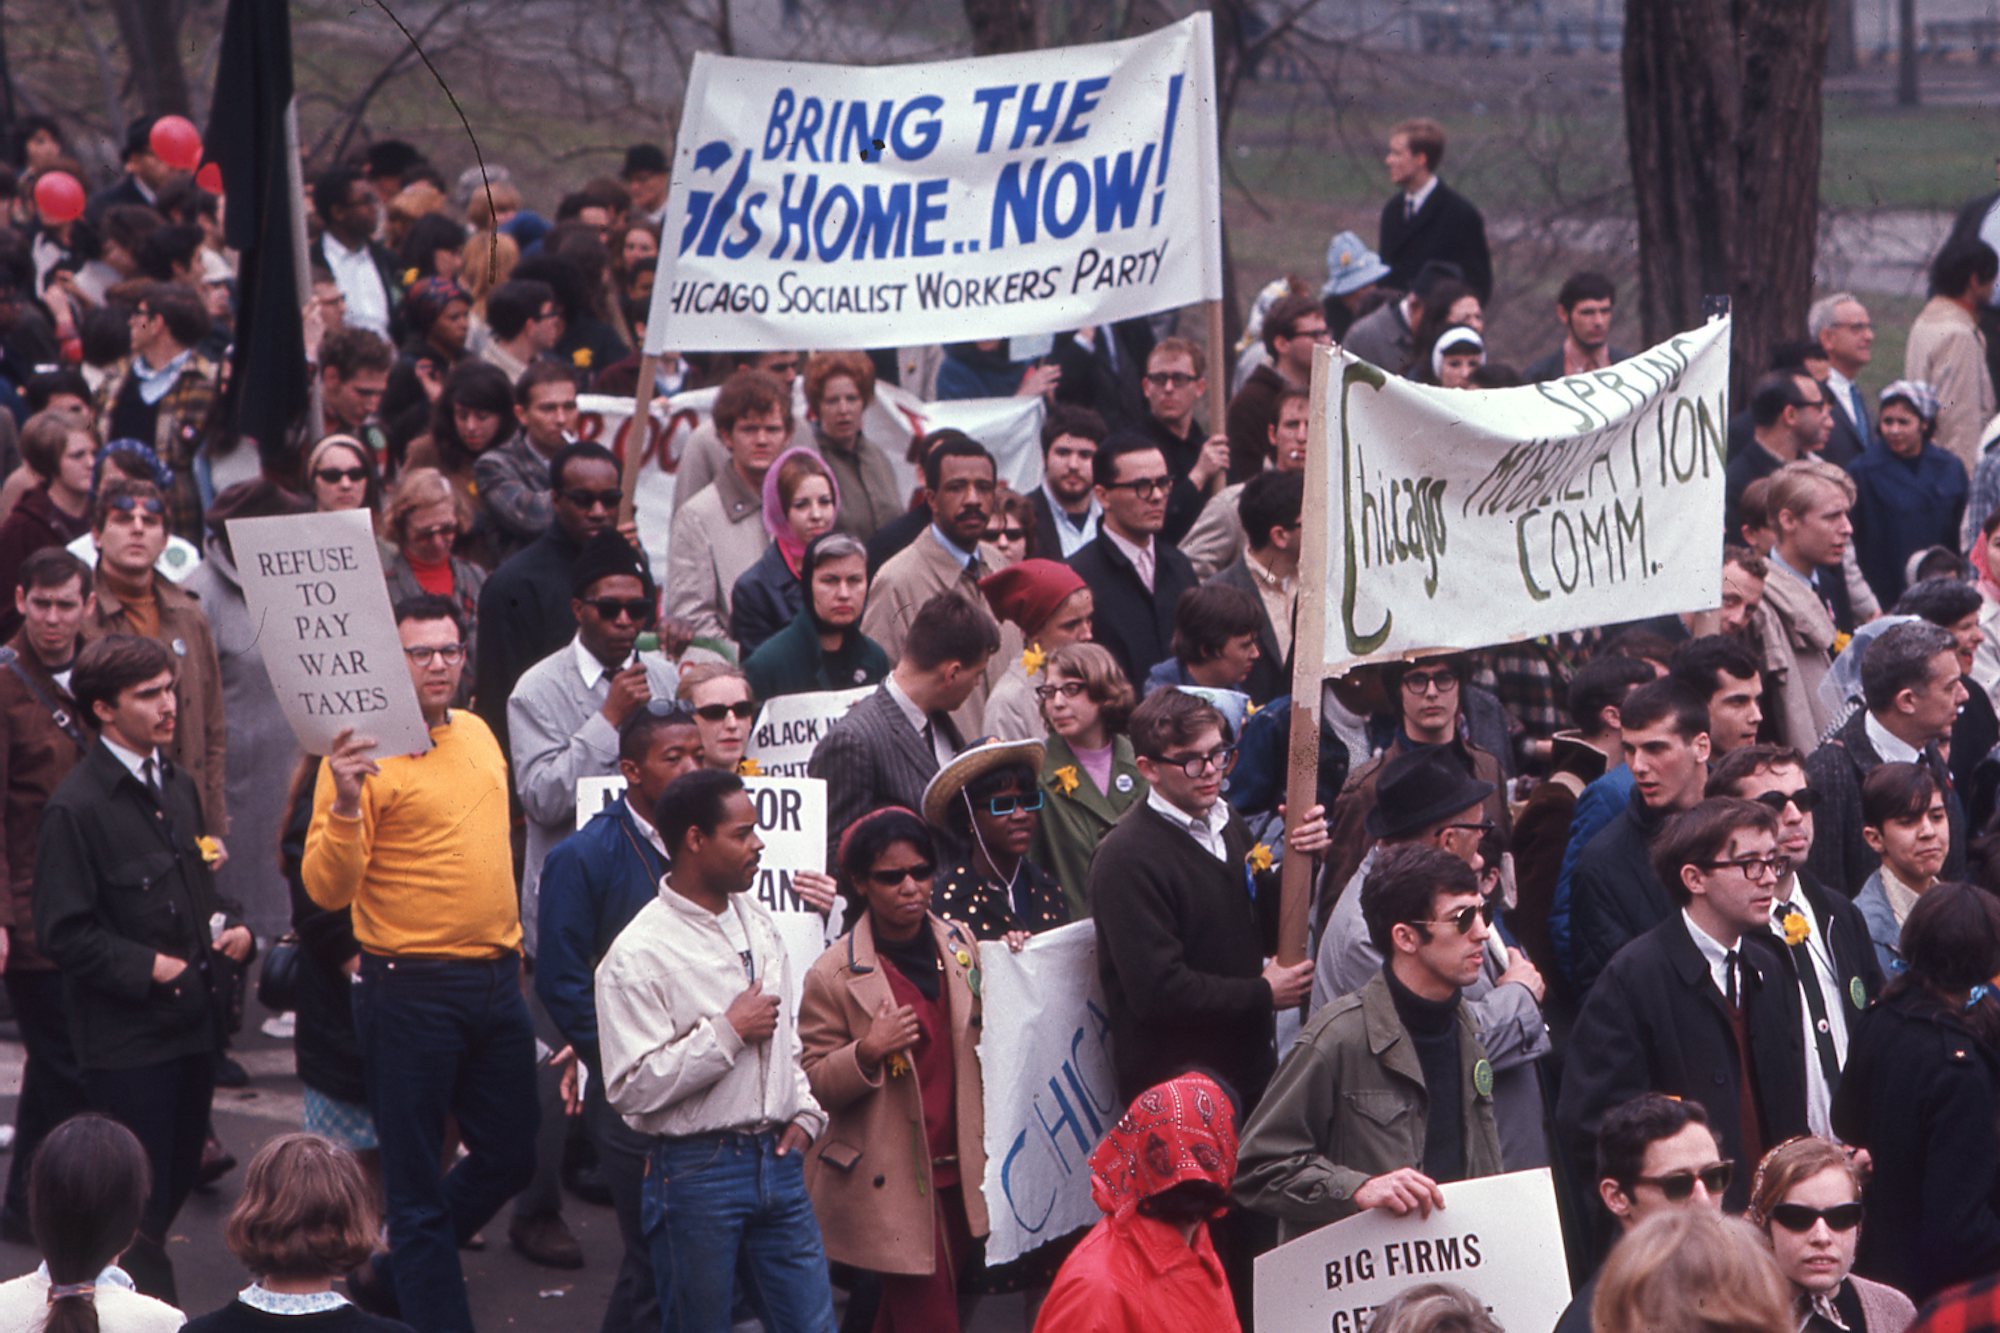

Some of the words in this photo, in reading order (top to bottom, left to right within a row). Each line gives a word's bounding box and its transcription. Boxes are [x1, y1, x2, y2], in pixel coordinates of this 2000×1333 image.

[763, 88, 945, 164] BRING
[973, 76, 1111, 154] THE
[989, 73, 1185, 251] NOW!
[671, 281, 769, 314] HICAGO
[1071, 238, 1169, 294] PARTY
[1341, 361, 1447, 656] Chicago
[258, 546, 359, 577] REFUSE
[1516, 496, 1659, 601] COMM.
[296, 581, 337, 607] TO
[295, 613, 350, 640] PAY
[298, 650, 371, 676] WAR
[299, 687, 389, 715] TAXES
[757, 717, 819, 748] BLACK
[744, 787, 802, 831] OR
[1325, 1249, 1376, 1290] BIG
[1385, 1233, 1482, 1276] FIRMS
